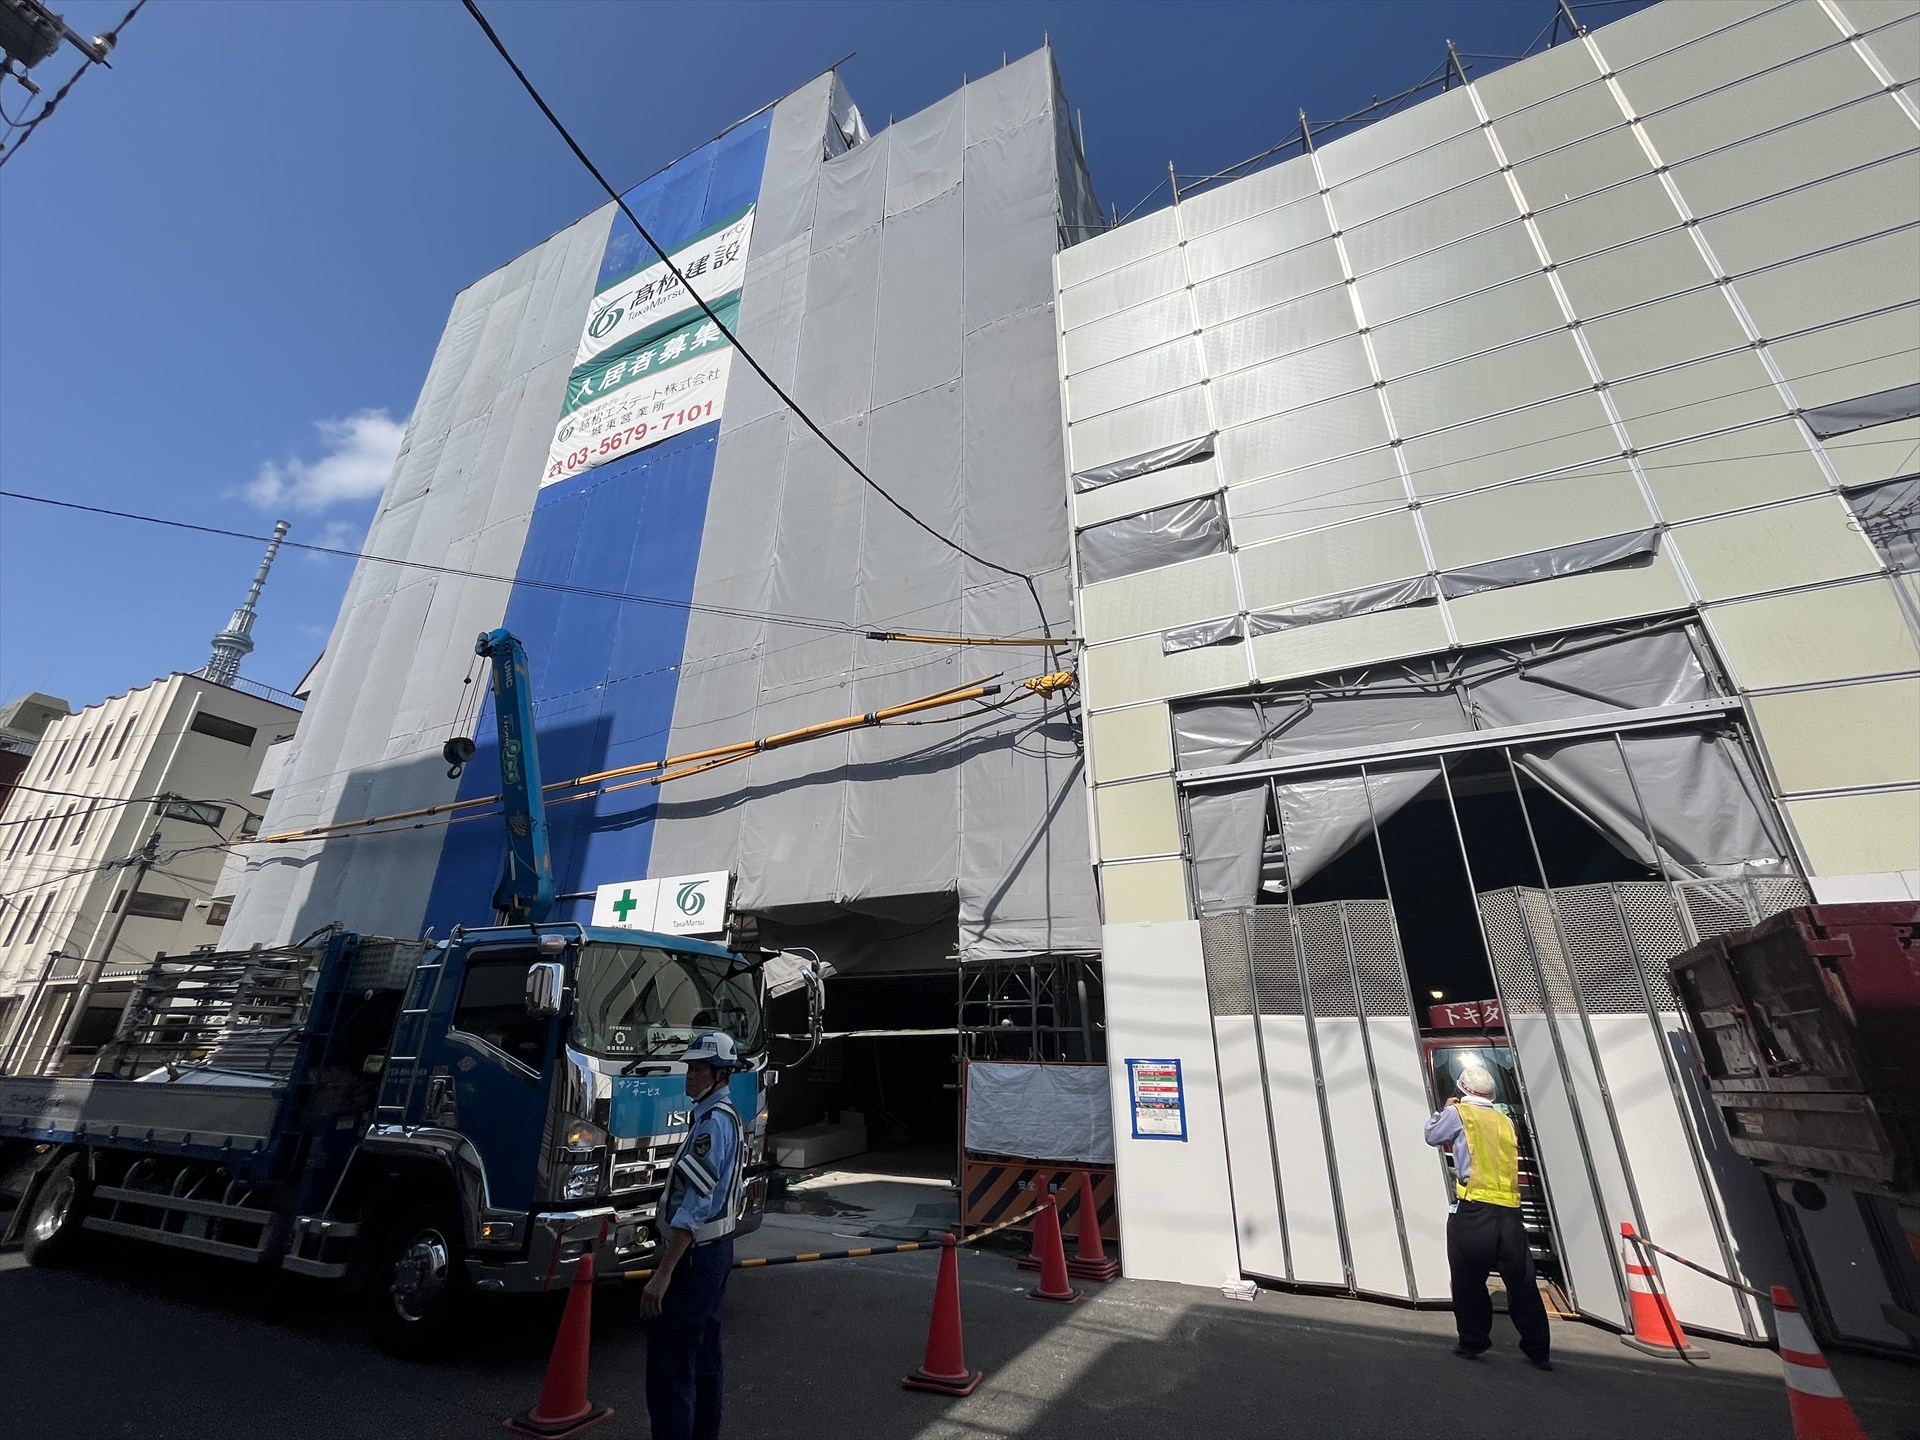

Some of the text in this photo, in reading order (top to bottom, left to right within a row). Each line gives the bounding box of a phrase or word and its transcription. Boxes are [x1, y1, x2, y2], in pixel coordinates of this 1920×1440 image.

[572, 319, 722, 405] 入居者募集
[566, 400, 713, 470] 03-5679-7101
[503, 660, 514, 689] UNIC
[619, 1080, 647, 1089] サンコー
[632, 1087, 660, 1098] サービス
